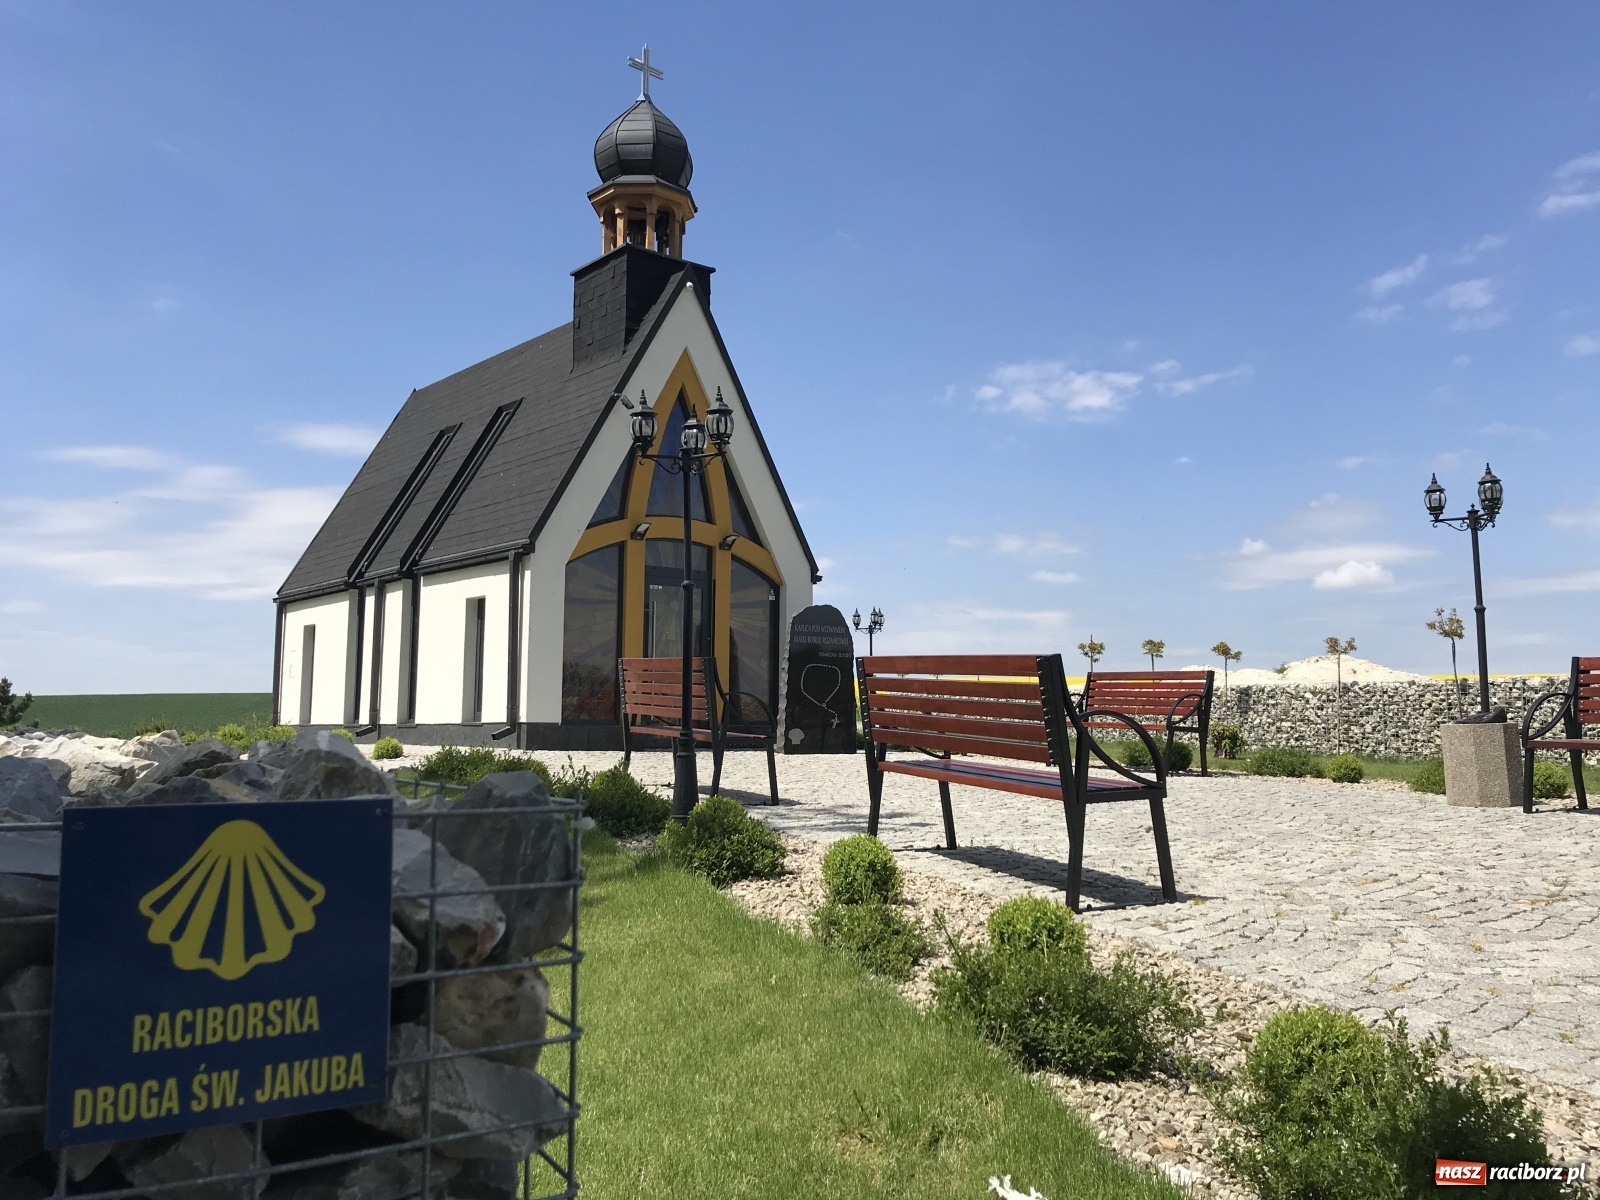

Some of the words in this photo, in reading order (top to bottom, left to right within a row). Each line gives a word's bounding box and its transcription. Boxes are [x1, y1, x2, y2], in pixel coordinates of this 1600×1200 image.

[132, 995, 320, 1053] RACIBORSKA
[72, 1077, 180, 1129] DROGA
[190, 1063, 245, 1113] ŚW.
[255, 1052, 365, 1103] JAKUBA
